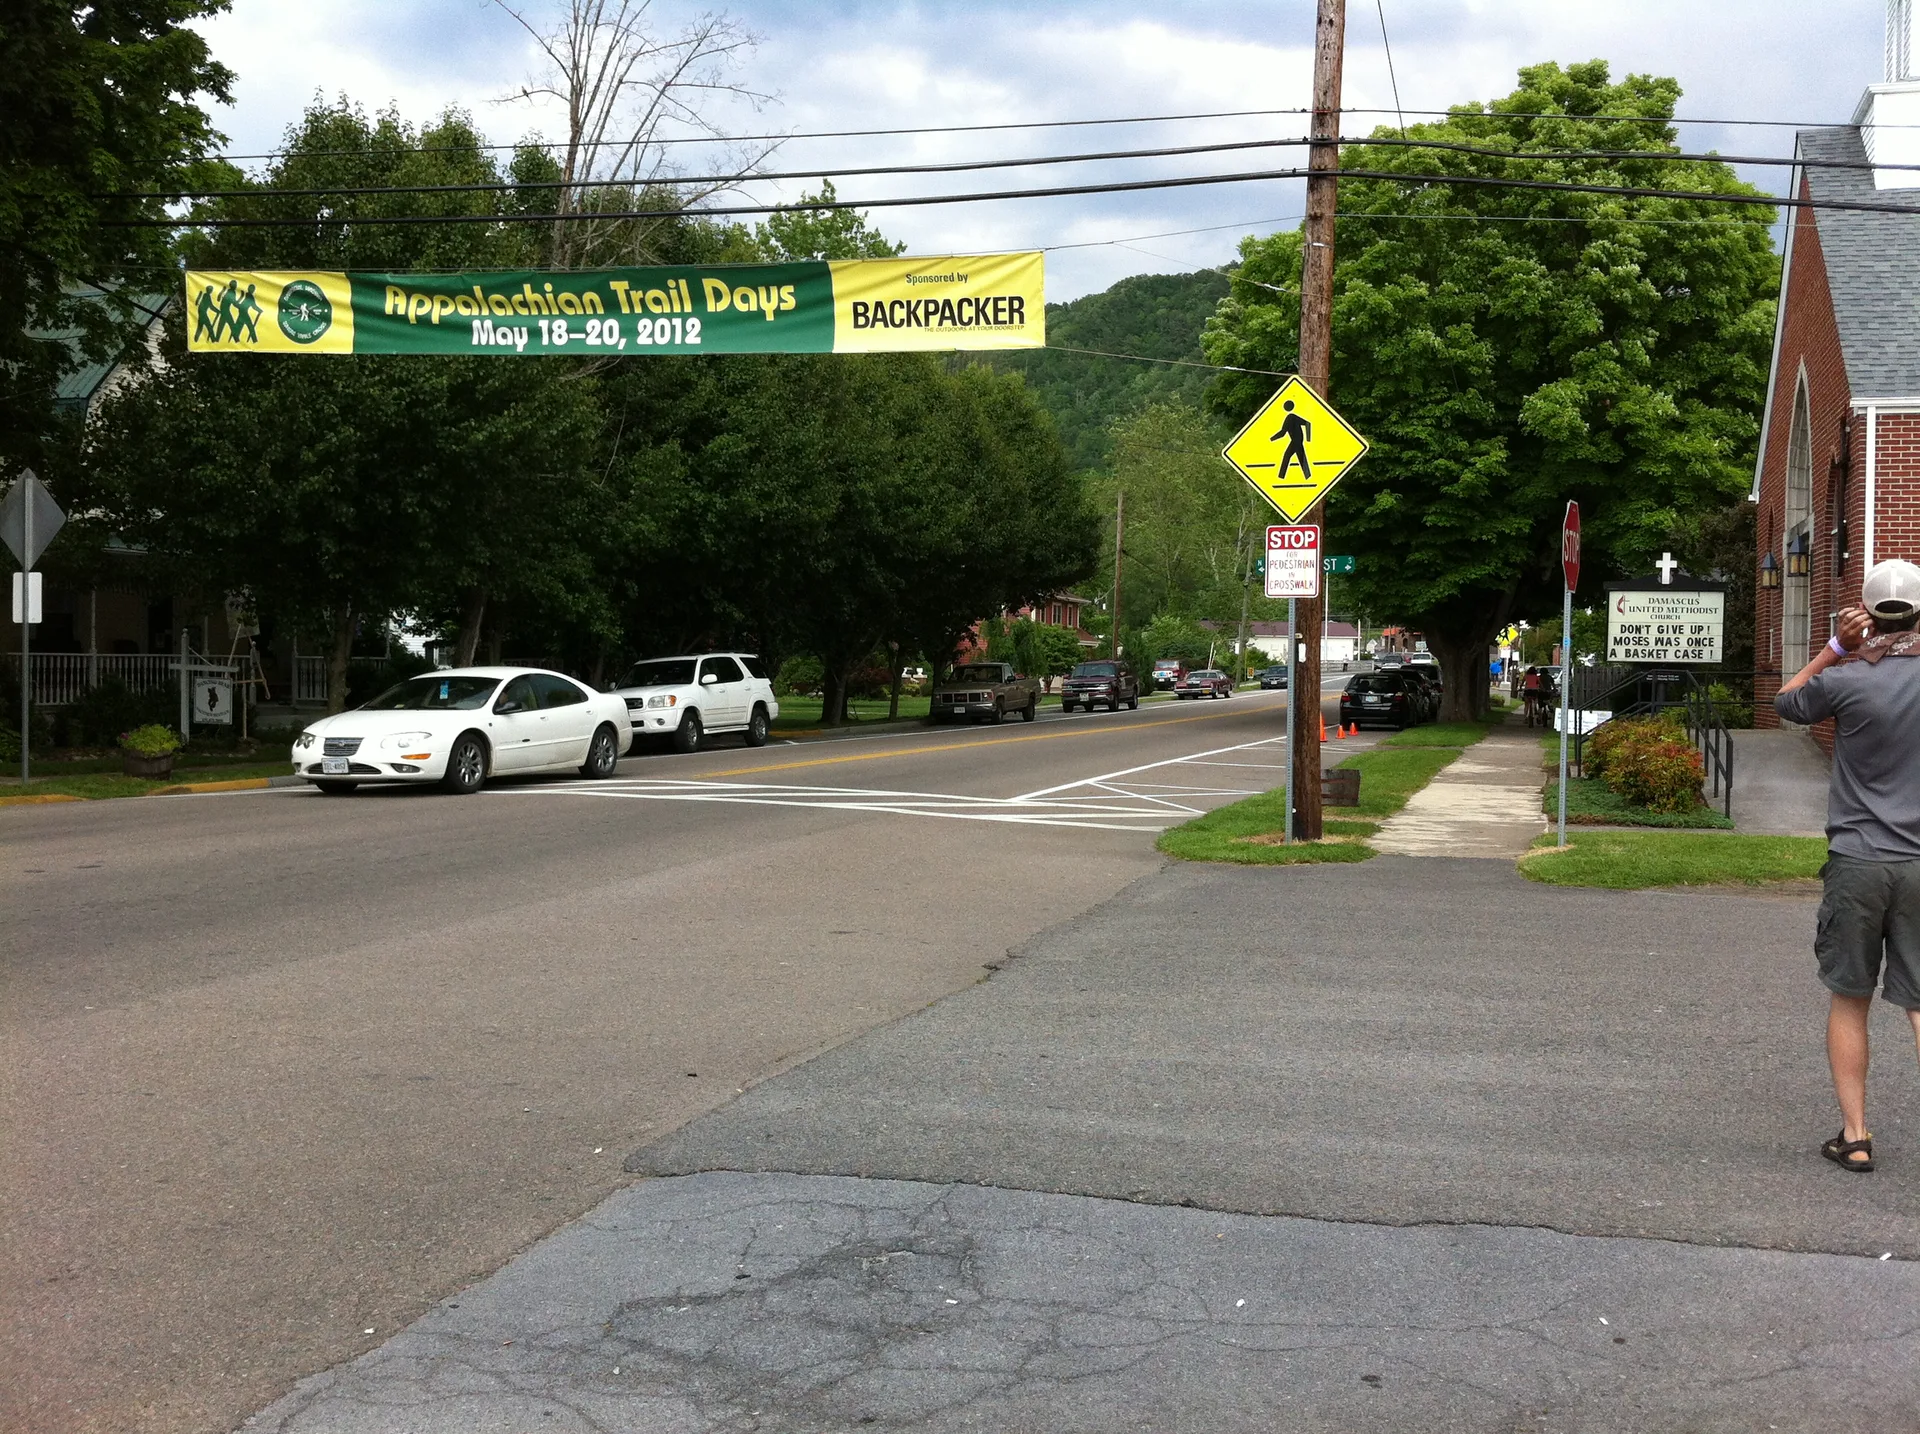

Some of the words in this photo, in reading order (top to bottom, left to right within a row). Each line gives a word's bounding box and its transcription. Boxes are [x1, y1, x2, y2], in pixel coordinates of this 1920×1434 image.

[905, 272, 954, 285] Sponsored
[957, 272, 969, 284] by
[384, 282, 605, 324] Appalachian
[609, 279, 693, 314] Trail
[701, 277, 796, 321] Days
[852, 296, 1025, 329] BACKPACKER
[471, 318, 529, 352] May
[636, 317, 702, 346] 2012
[1269, 530, 1316, 548] STOP
[1564, 528, 1580, 564] STOP
[1269, 559, 1315, 569] PEDESTRIAN
[1323, 558, 1337, 571] ST
[1269, 579, 1314, 590] CROSSWALK
[1648, 597, 1700, 605] DAMASCUS
[1628, 605, 1664, 613] UNITED
[1666, 606, 1719, 614] METHODIST
[1620, 624, 1651, 634] DON'T
[1657, 625, 1684, 634] GIVE
[1613, 636, 1650, 646] MOSES
[1654, 637, 1681, 646] WAS
[1687, 637, 1714, 647] ONCE
[1609, 648, 1617, 658] A
[1625, 648, 1669, 659] BASKET
